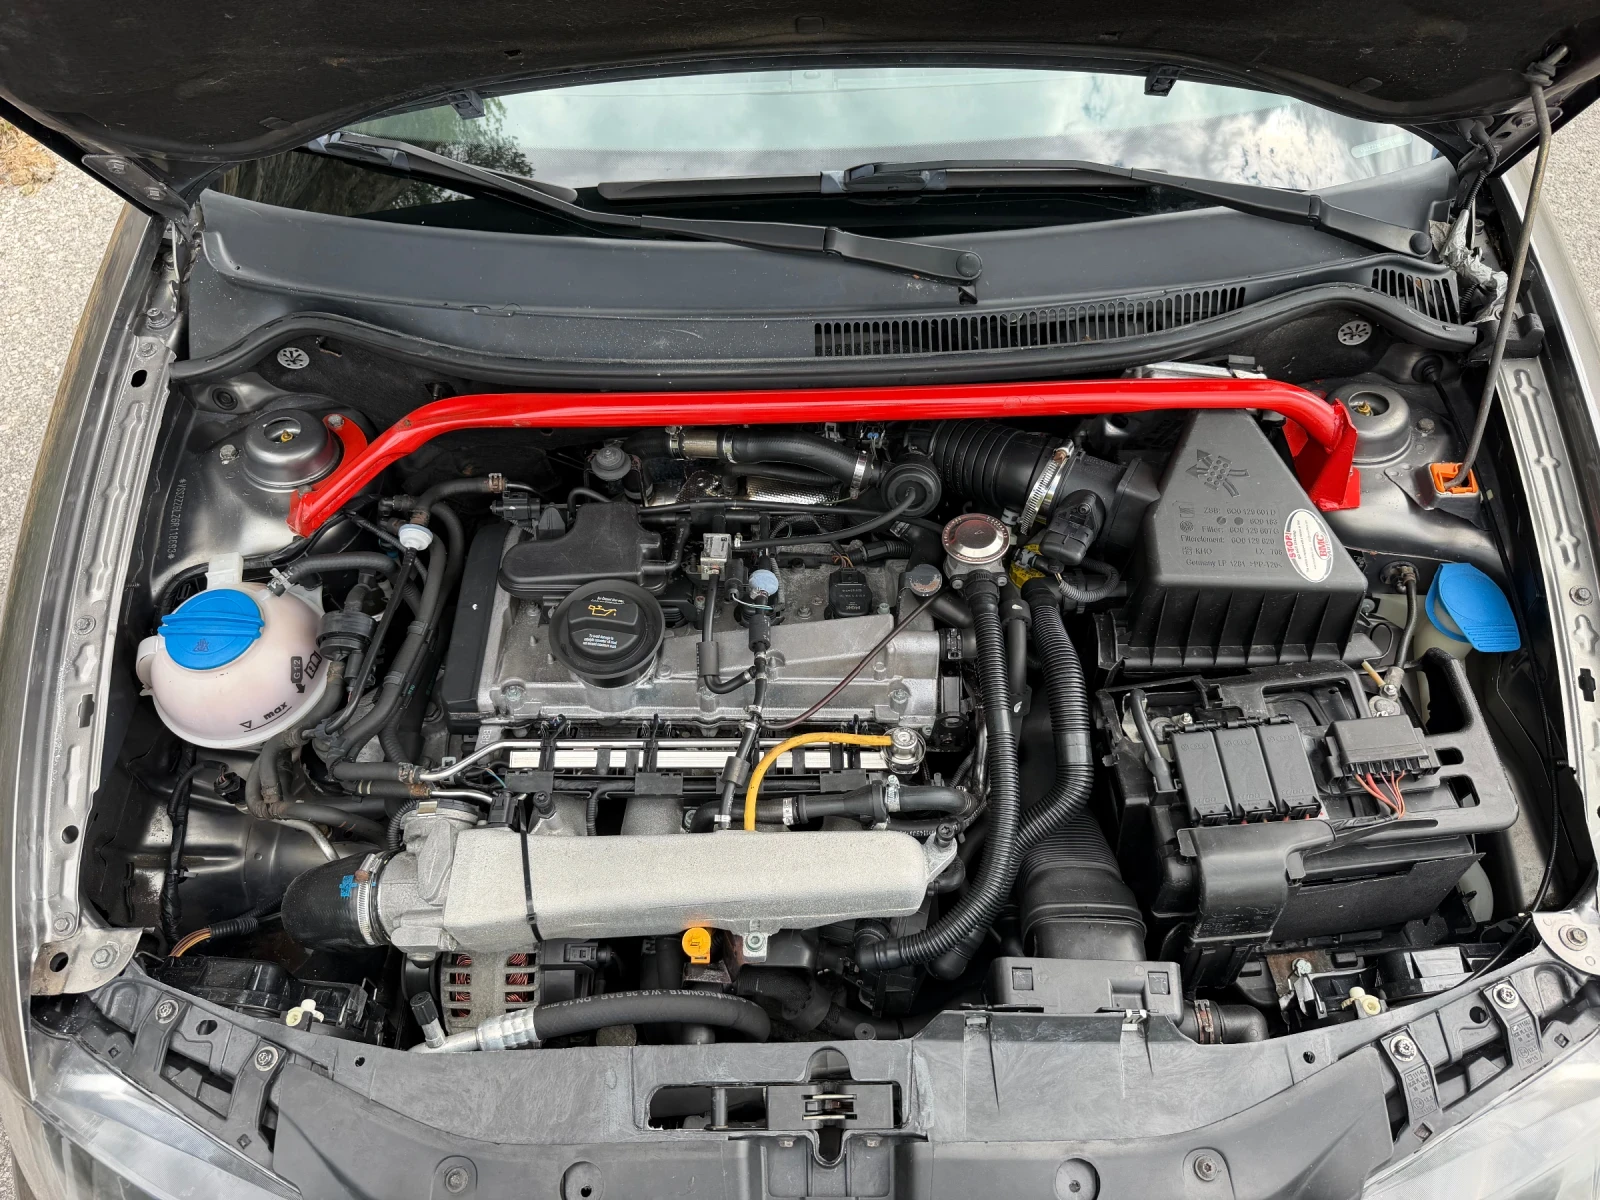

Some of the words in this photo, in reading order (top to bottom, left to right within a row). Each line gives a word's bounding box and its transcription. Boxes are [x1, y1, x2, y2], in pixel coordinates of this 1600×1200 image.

[1285, 532, 1296, 558] STOP!
[1316, 534, 1327, 557] BMC
[263, 702, 288, 720] max
